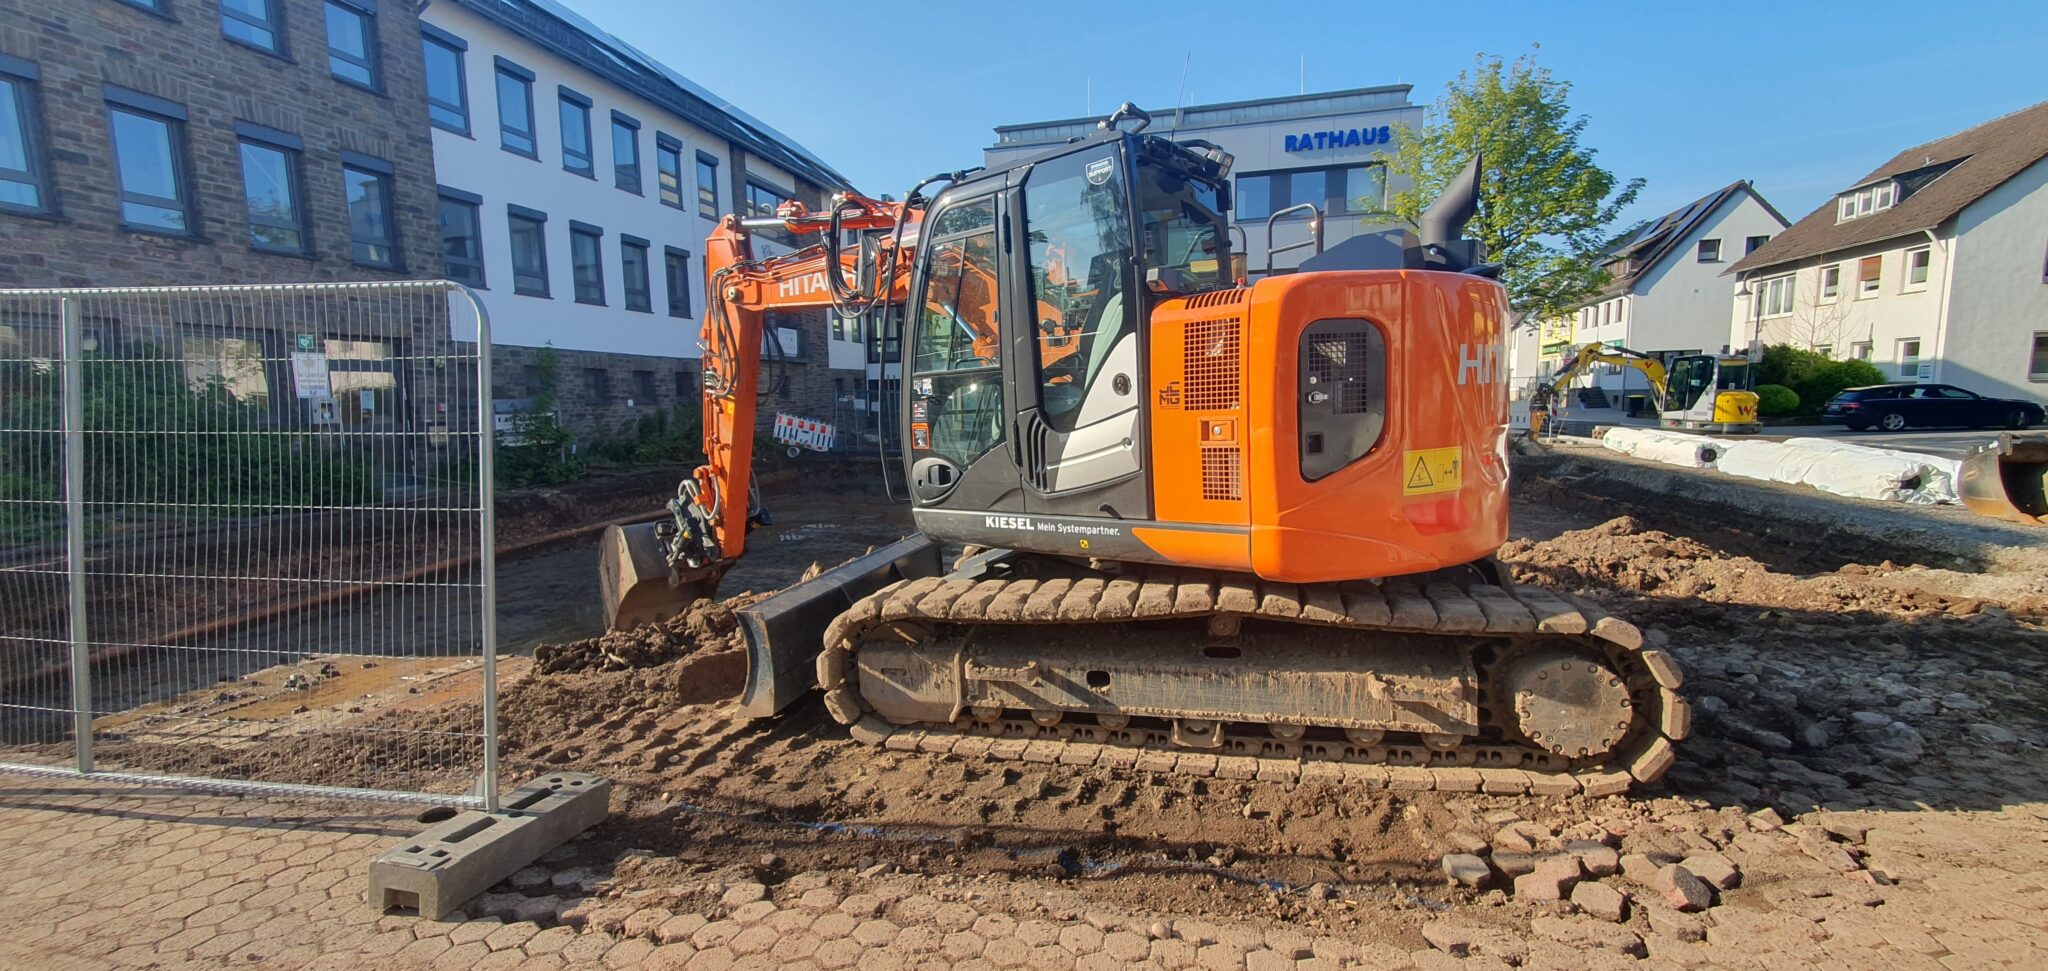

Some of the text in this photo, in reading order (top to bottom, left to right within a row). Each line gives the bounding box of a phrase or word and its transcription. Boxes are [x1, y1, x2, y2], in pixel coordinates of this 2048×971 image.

[1285, 126, 1391, 152] RATHAUS
[985, 516, 1121, 536] KIESEL Mein Systempartner.
